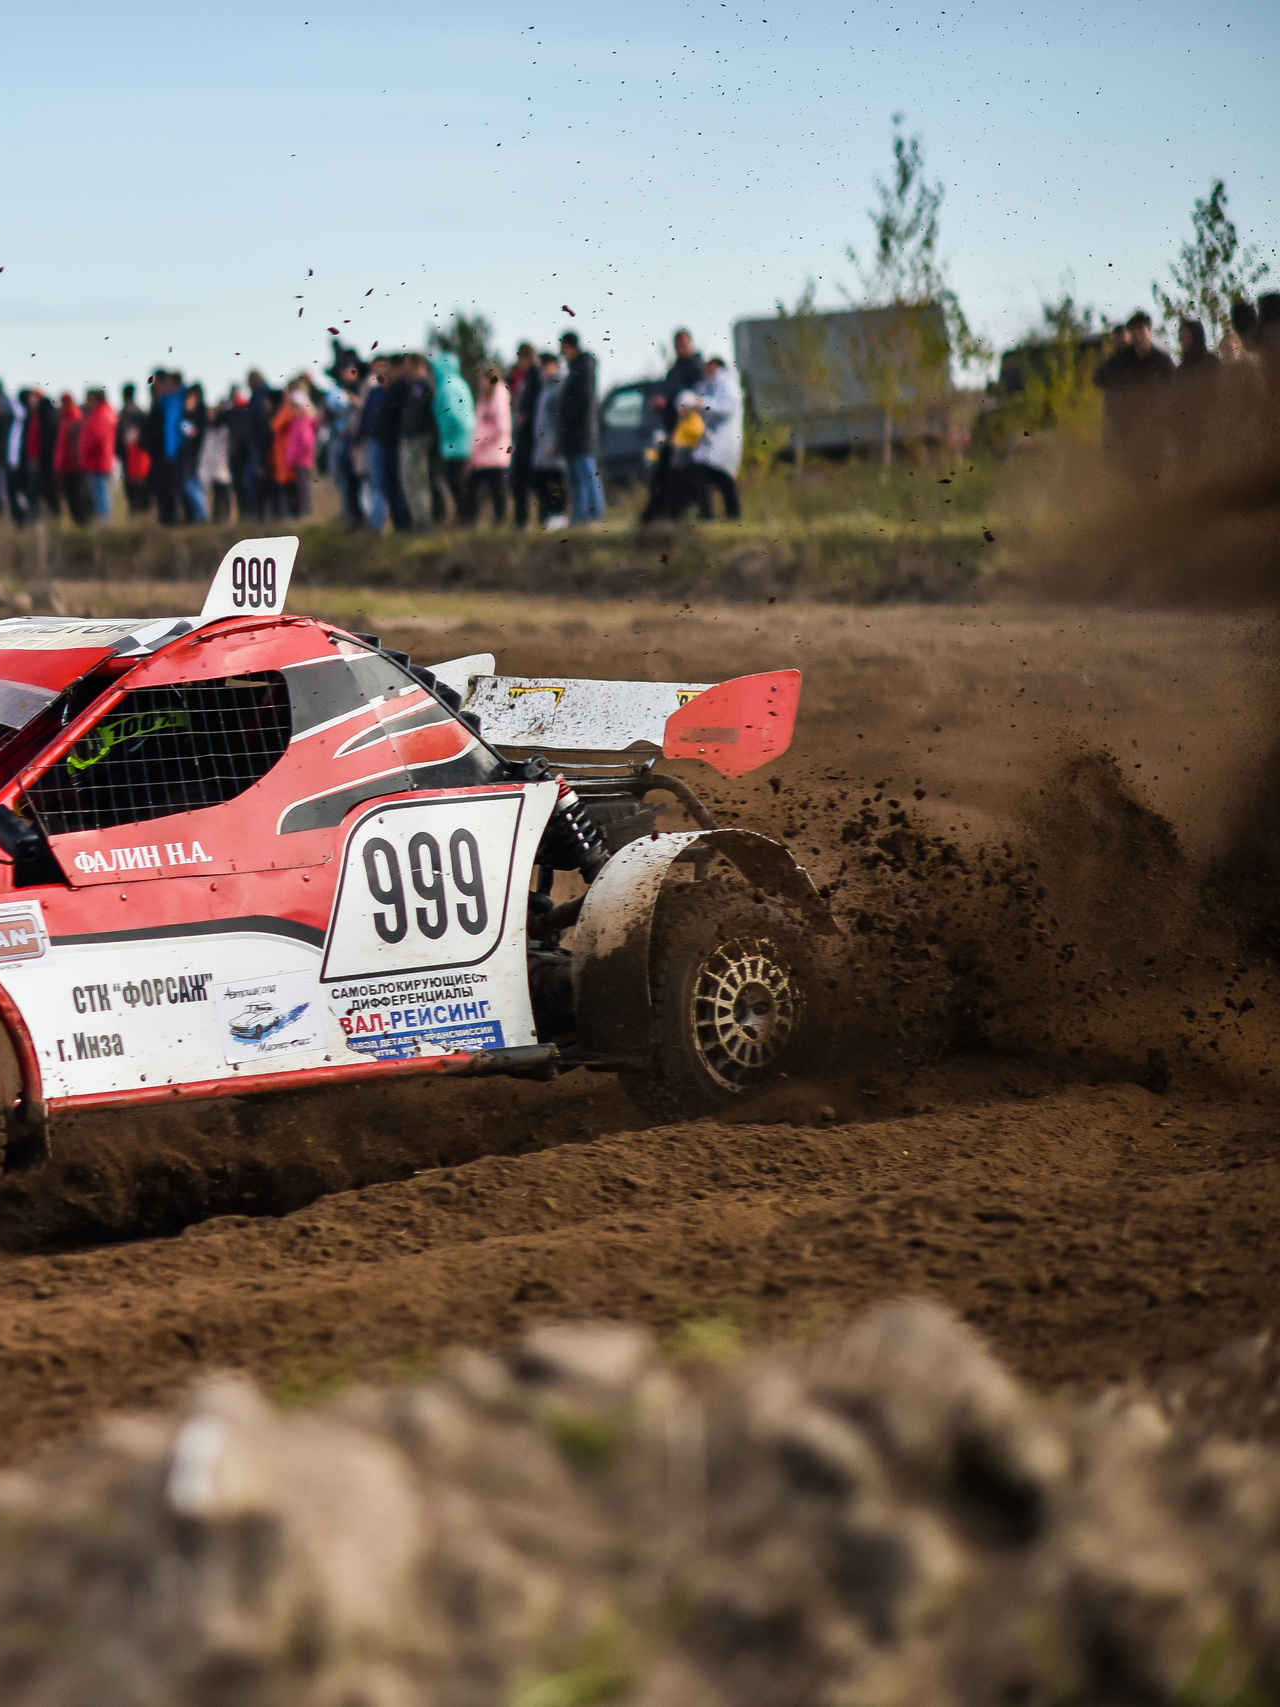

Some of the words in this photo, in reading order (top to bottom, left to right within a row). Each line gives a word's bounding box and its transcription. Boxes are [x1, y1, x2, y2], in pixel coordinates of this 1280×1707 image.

[232, 556, 277, 608] 999
[10, 623, 140, 635] MOTOR
[108, 711, 178, 741] 100%
[73, 845, 164, 874] ФАЛИН
[163, 840, 214, 866] Н.А.
[363, 828, 488, 944] 999
[72, 984, 113, 1014] СТК
[331, 974, 488, 999] САМОБЛОКИРУЮЩИЕСЯ
[350, 986, 474, 1012] ДИФФЕРЕНЦИАЛЫ
[339, 1000, 490, 1035] ВАЛ-РЕЙСИНГ
[57, 1038, 73, 1062] г.
[74, 1032, 124, 1060] Инза
